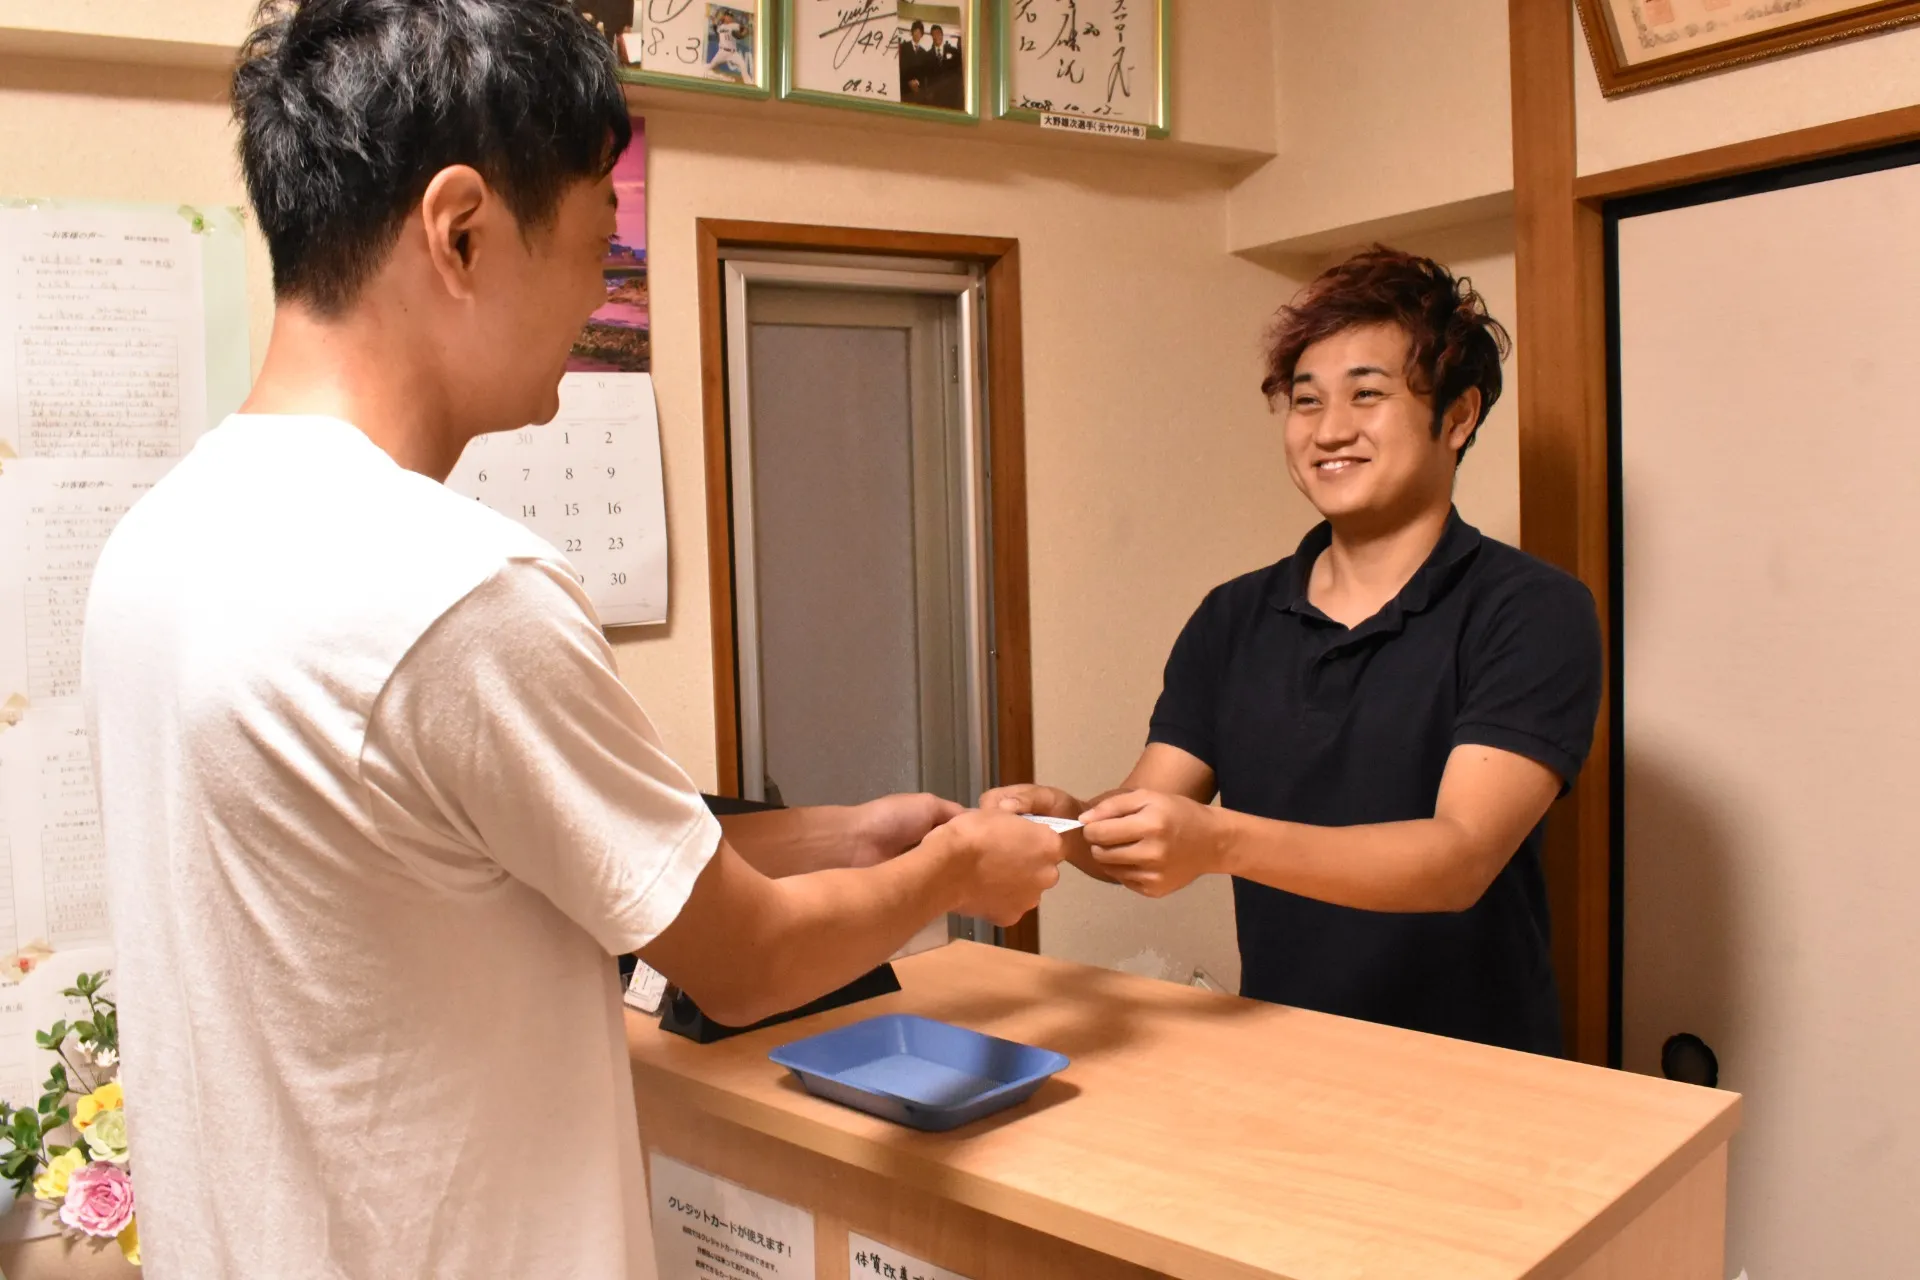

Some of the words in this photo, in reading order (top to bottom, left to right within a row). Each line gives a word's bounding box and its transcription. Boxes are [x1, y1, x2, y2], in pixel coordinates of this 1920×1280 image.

[857, 30, 884, 54] 49
[564, 431, 570, 445] 1
[605, 431, 613, 444] 2
[478, 470, 488, 482] 6
[522, 468, 531, 481] 7
[565, 467, 574, 480] 8
[606, 467, 616, 479] 9
[522, 504, 537, 518] 14
[564, 503, 580, 516] 15
[607, 501, 622, 515] 16
[565, 538, 582, 552] 22
[608, 536, 624, 550] 23
[610, 572, 627, 586] 30
